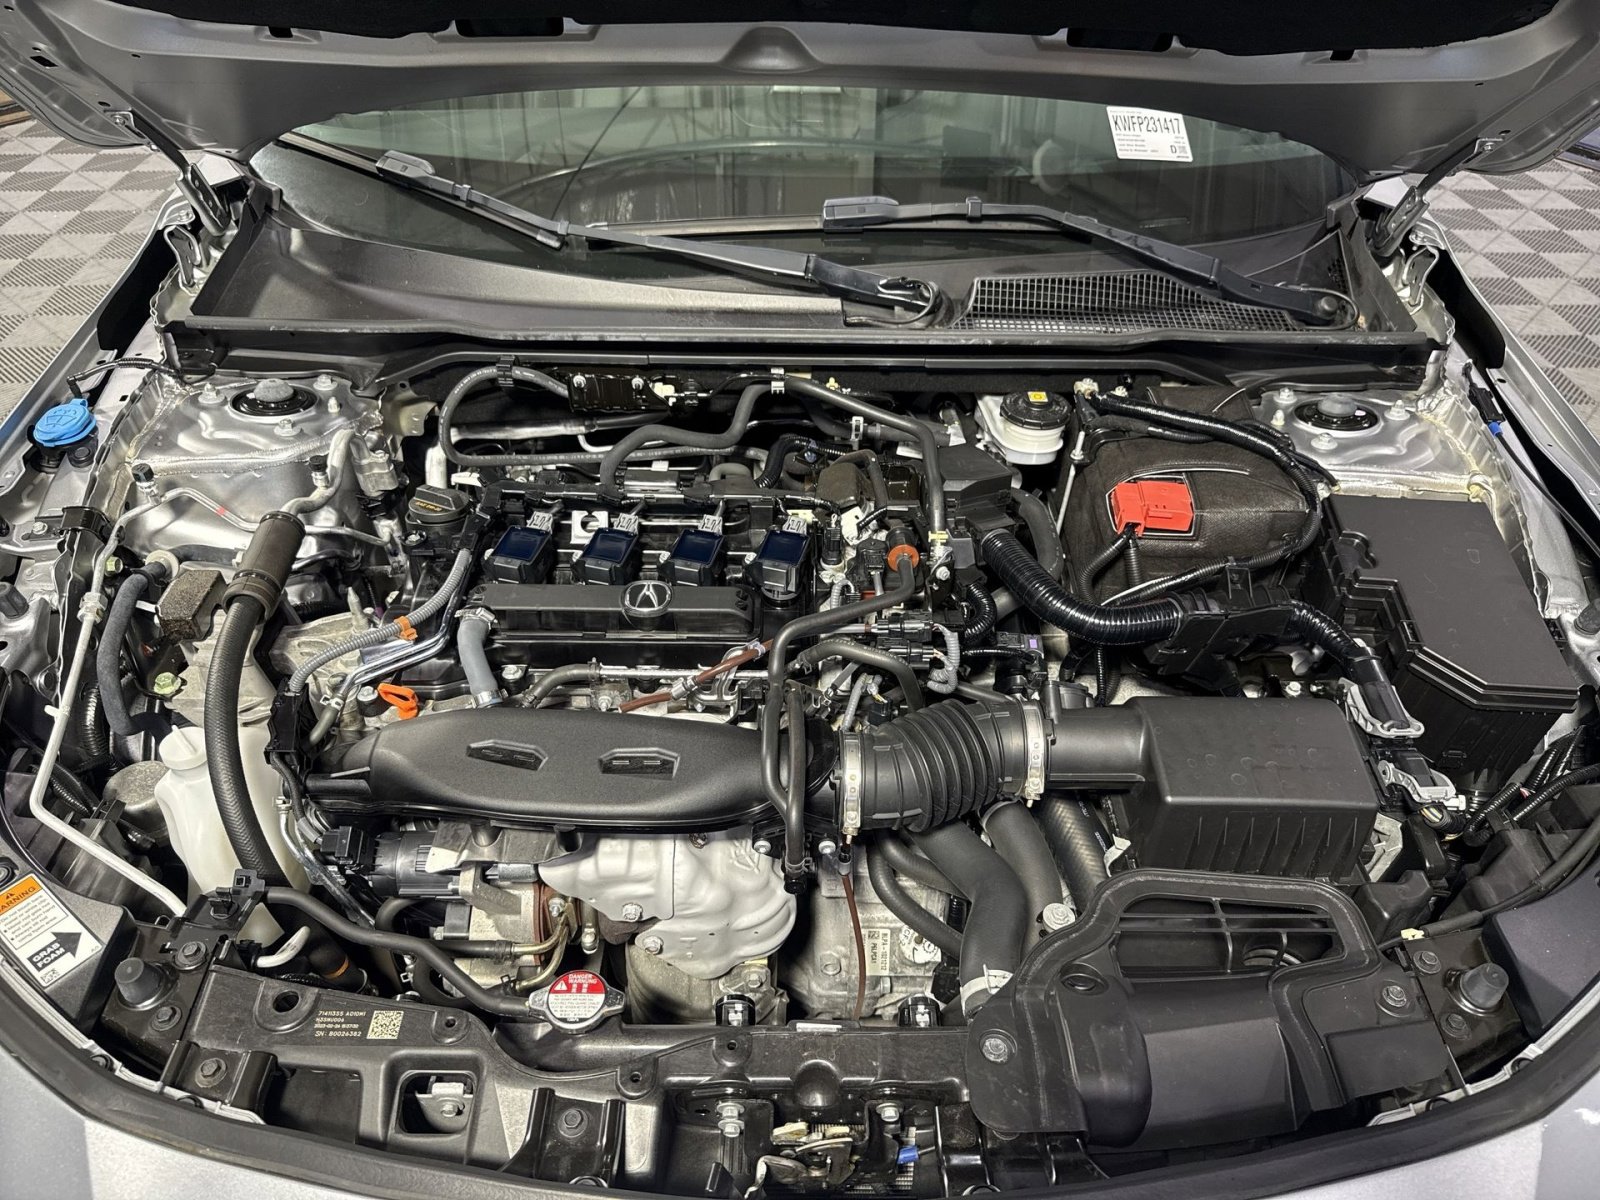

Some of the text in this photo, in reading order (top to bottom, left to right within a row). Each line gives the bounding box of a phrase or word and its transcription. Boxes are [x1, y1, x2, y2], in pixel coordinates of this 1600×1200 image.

[1112, 115, 1181, 134] KWFP231417
[1170, 145, 1177, 153] D
[0, 886, 36, 912] ARNING
[32, 942, 61, 963] GRAB
[36, 947, 66, 969] FOAM
